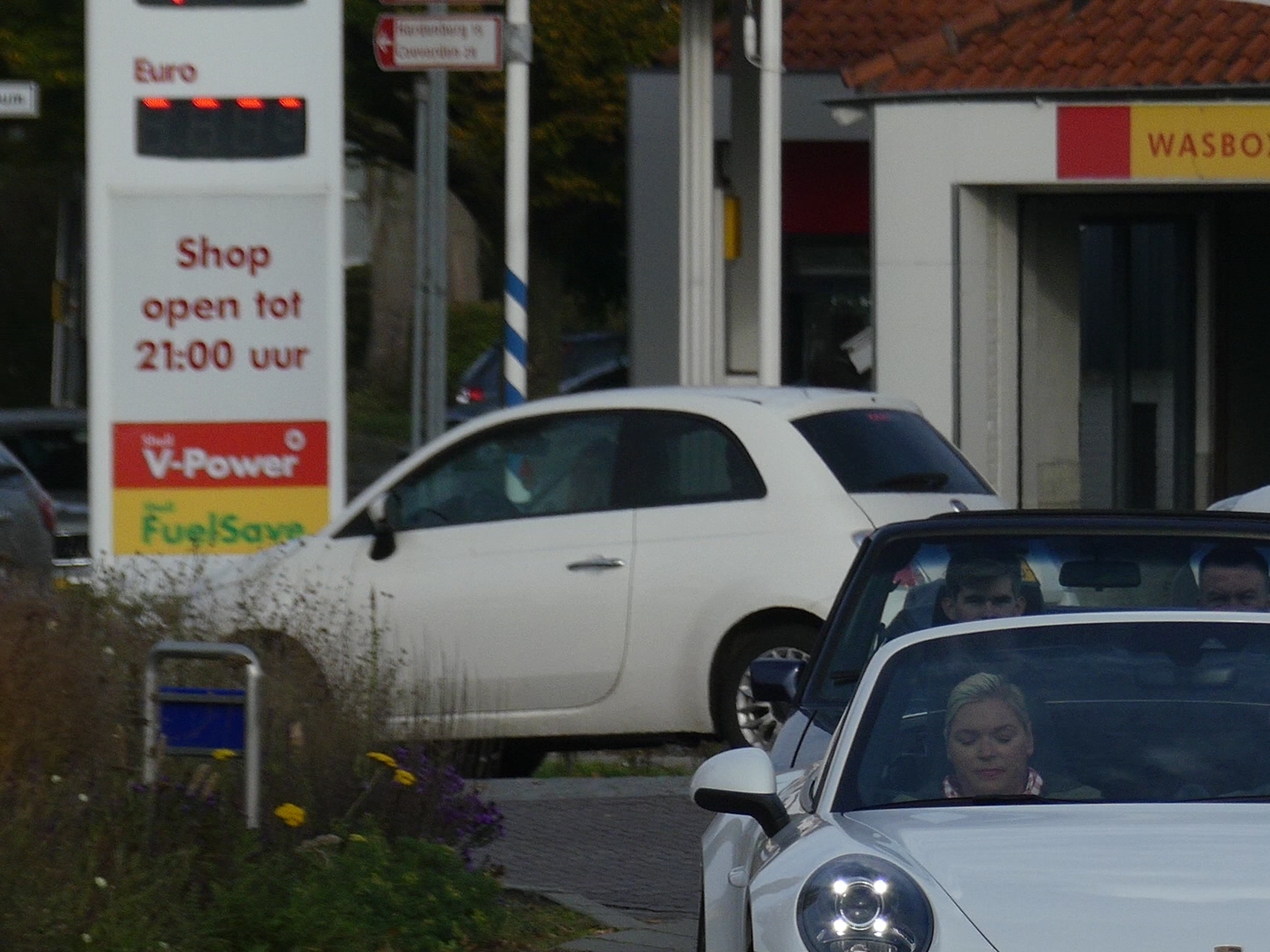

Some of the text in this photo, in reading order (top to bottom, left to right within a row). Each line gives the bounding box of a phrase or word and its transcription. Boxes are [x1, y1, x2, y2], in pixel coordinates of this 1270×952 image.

[134, 57, 198, 83] Euro
[176, 236, 272, 277] Shop
[142, 290, 302, 329] open tot
[136, 339, 310, 371] 21:00 uur
[142, 447, 300, 480] V-Power
[142, 513, 305, 546] FuelSave
